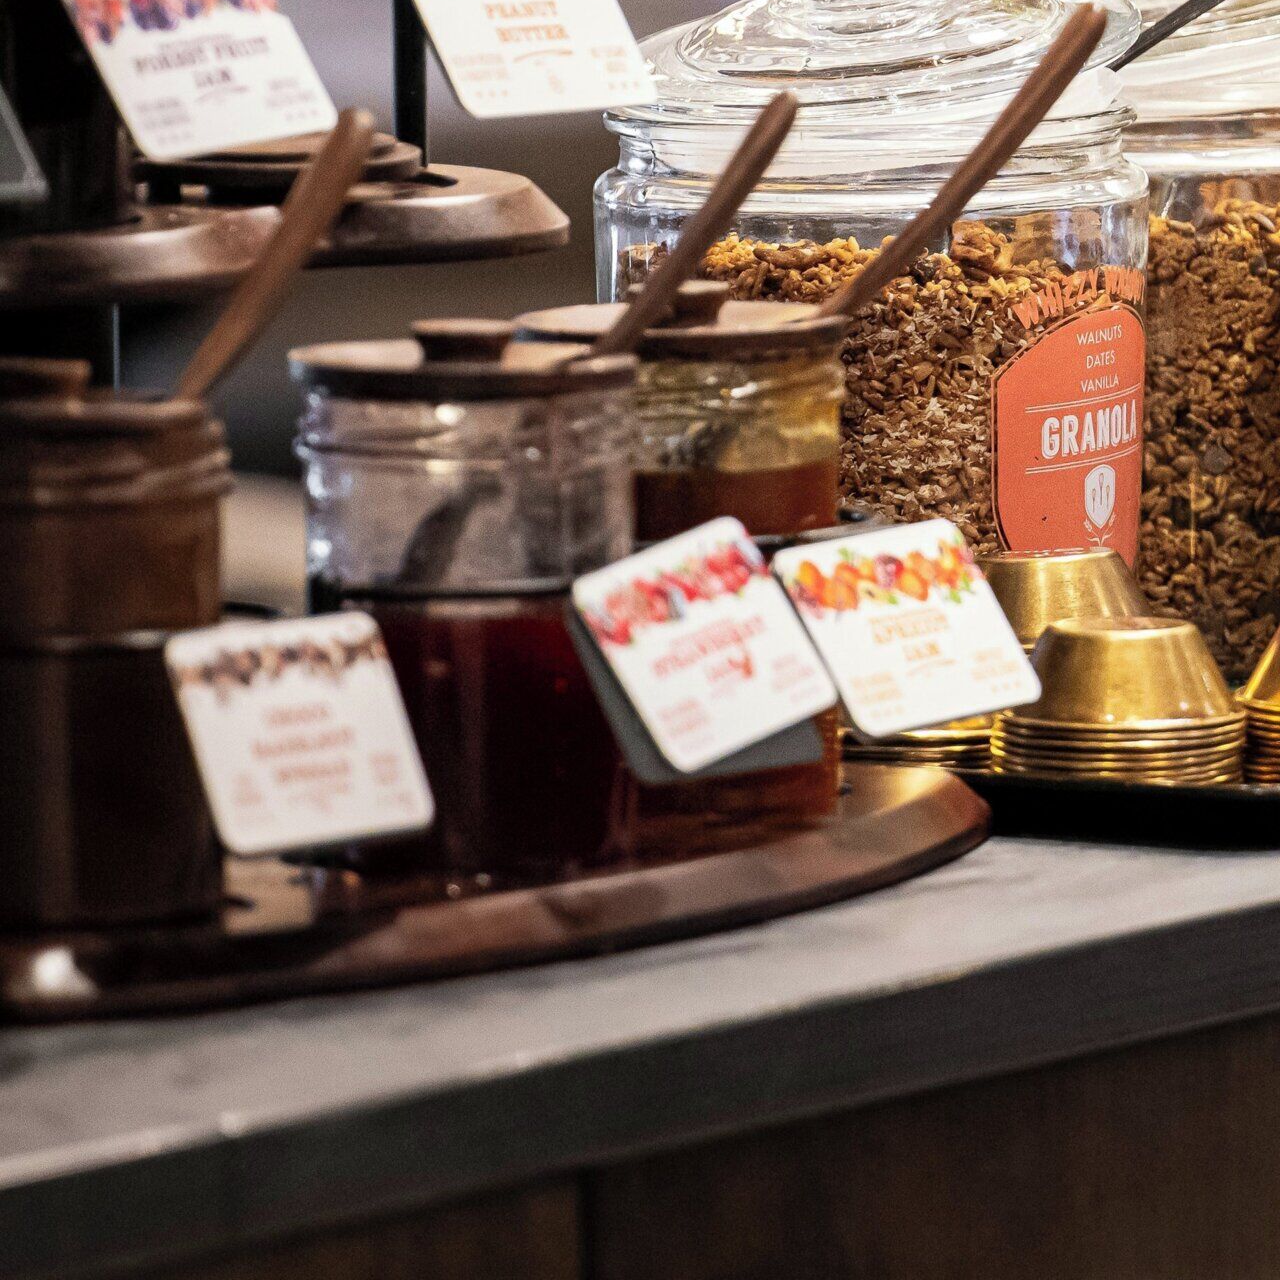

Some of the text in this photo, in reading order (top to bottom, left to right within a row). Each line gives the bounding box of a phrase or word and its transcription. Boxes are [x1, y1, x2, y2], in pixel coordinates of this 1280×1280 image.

[1011, 268, 1099, 330] WHIZZY
[1076, 324, 1122, 346] WALNUTS
[1086, 350, 1116, 369] DATES
[1080, 373, 1120, 393] VANILLA
[1041, 398, 1137, 460] GRANOLA
